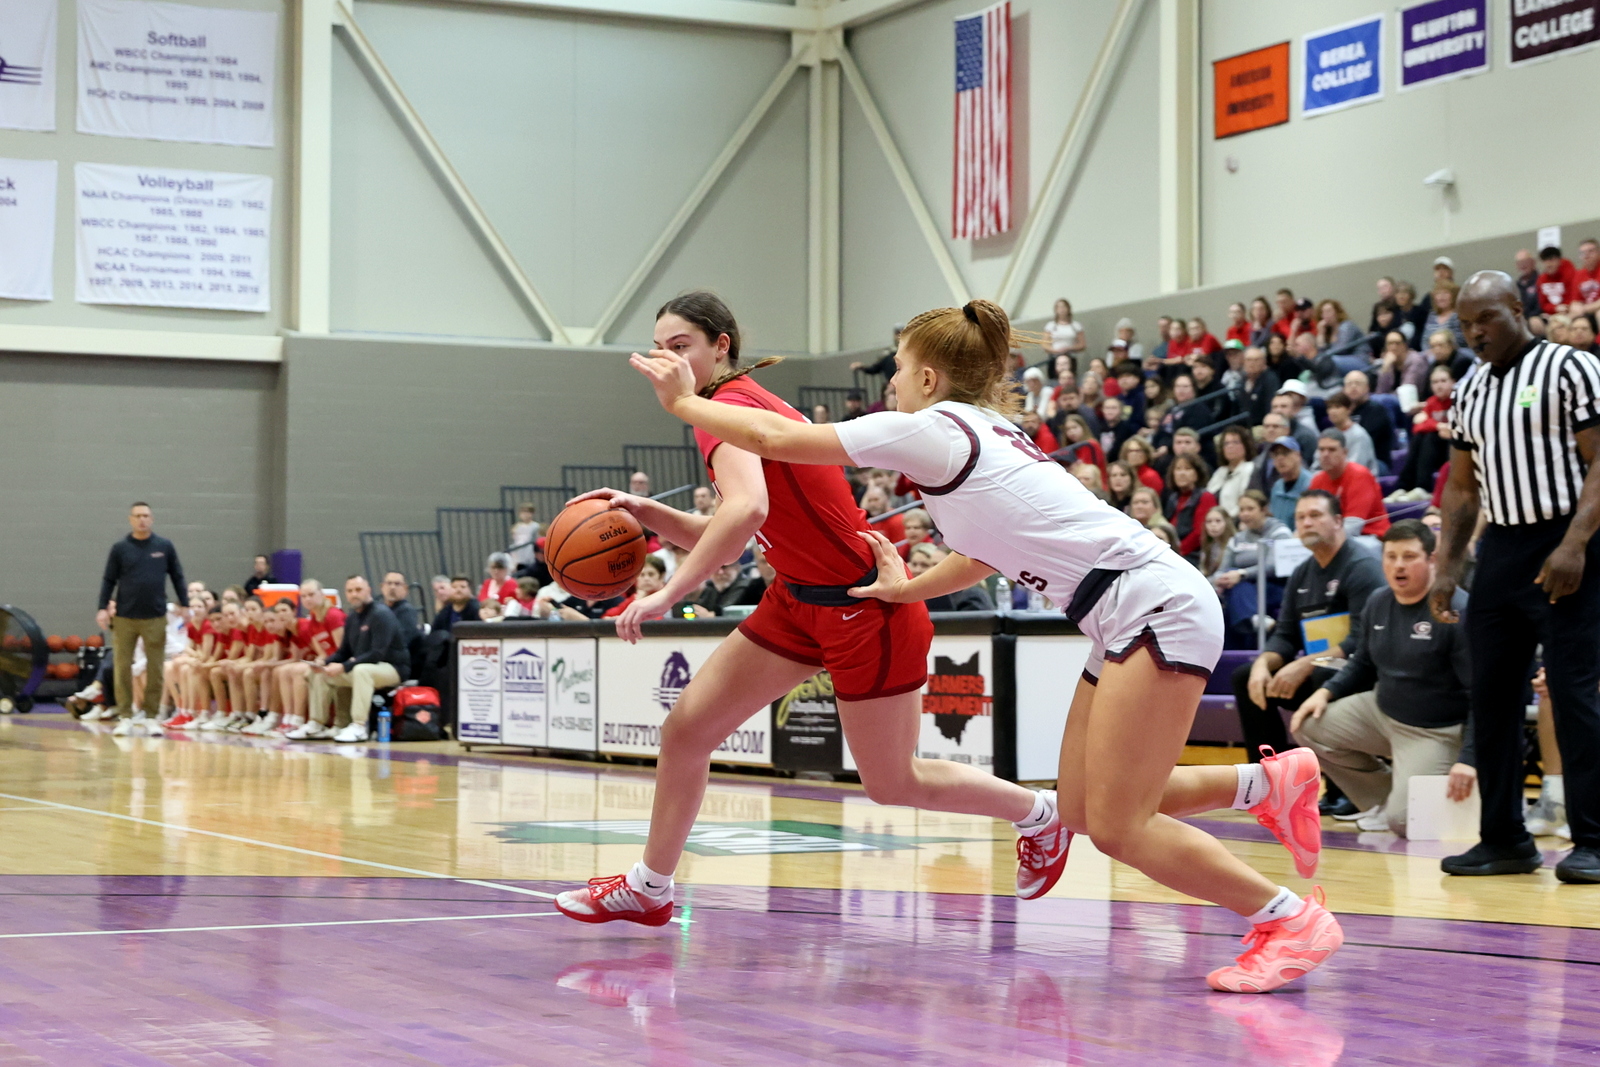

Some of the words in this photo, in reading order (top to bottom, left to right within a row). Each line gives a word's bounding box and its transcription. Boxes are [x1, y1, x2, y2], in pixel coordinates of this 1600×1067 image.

[1412, 8, 1477, 42] BLUFFTON
[1515, 7, 1595, 49] COLLEGE
[147, 30, 207, 48] Softball
[1404, 30, 1484, 68] UNIVERSITY
[1319, 41, 1366, 69] BEREA
[1312, 60, 1372, 92] COLLEGE
[137, 174, 214, 192] Volleyball
[599, 527, 622, 542] NFHS
[504, 660, 544, 680] STOLLY
[928, 674, 985, 695] FARMERS
[922, 695, 994, 716] EQUIPMENT
